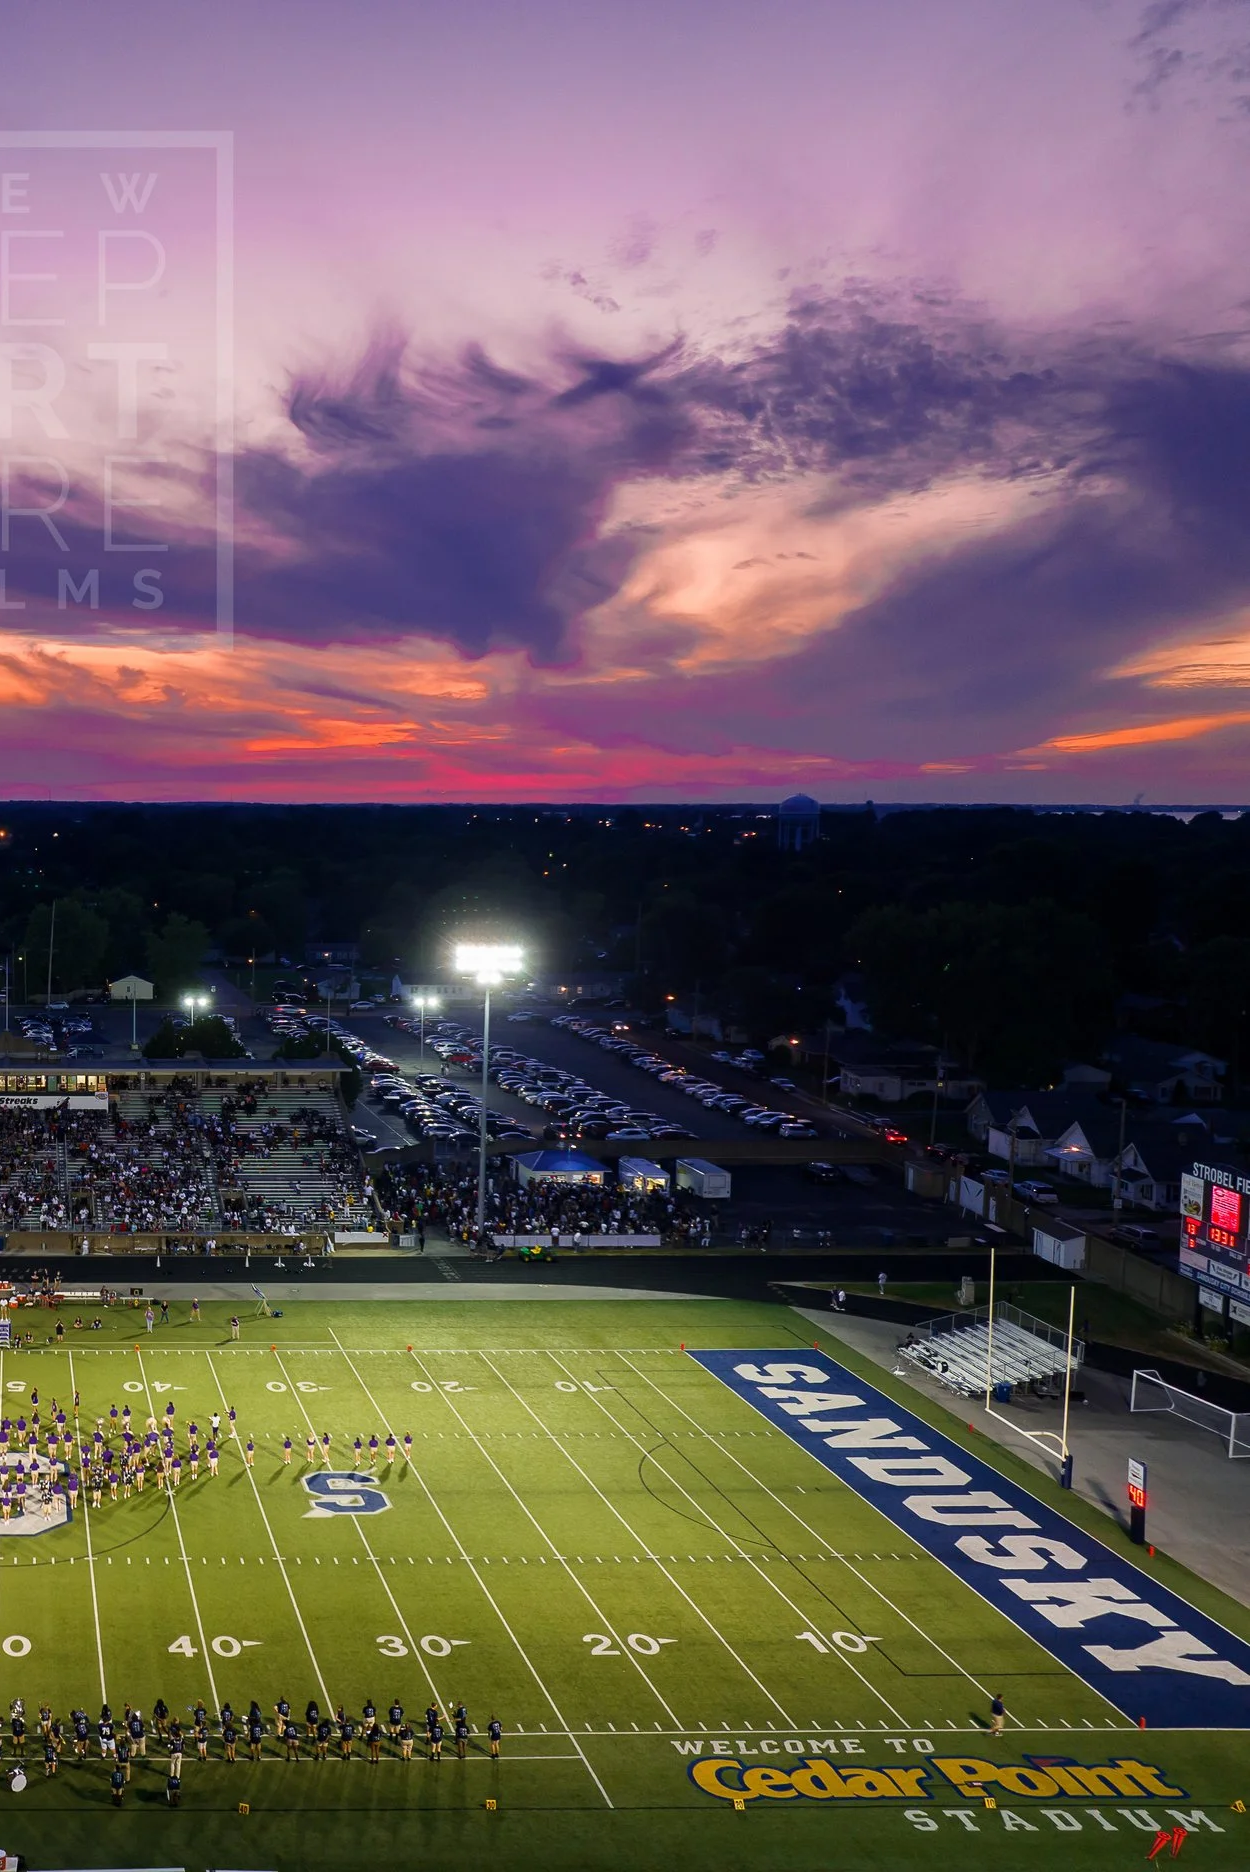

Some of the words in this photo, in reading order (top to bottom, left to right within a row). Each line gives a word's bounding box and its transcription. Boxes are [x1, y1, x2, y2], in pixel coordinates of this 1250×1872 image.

[1192, 1162, 1234, 1189] STROBEL
[123, 1380, 178, 1393] 40
[266, 1381, 320, 1393] 30
[410, 1380, 465, 1393] 20
[555, 1380, 608, 1393] 10
[1129, 1485, 1144, 1507] 40
[732, 1363, 1250, 1686] SANDUSKY
[168, 1635, 243, 1658] 40
[376, 1635, 452, 1657] 30
[582, 1633, 661, 1656] 20
[795, 1631, 867, 1653] 10
[670, 1739, 868, 1756] WELCOME
[884, 1738, 936, 1754] TO
[691, 1757, 929, 1801] Cedar
[930, 1754, 1187, 1799] Point
[904, 1809, 1226, 1832] STADIUM
